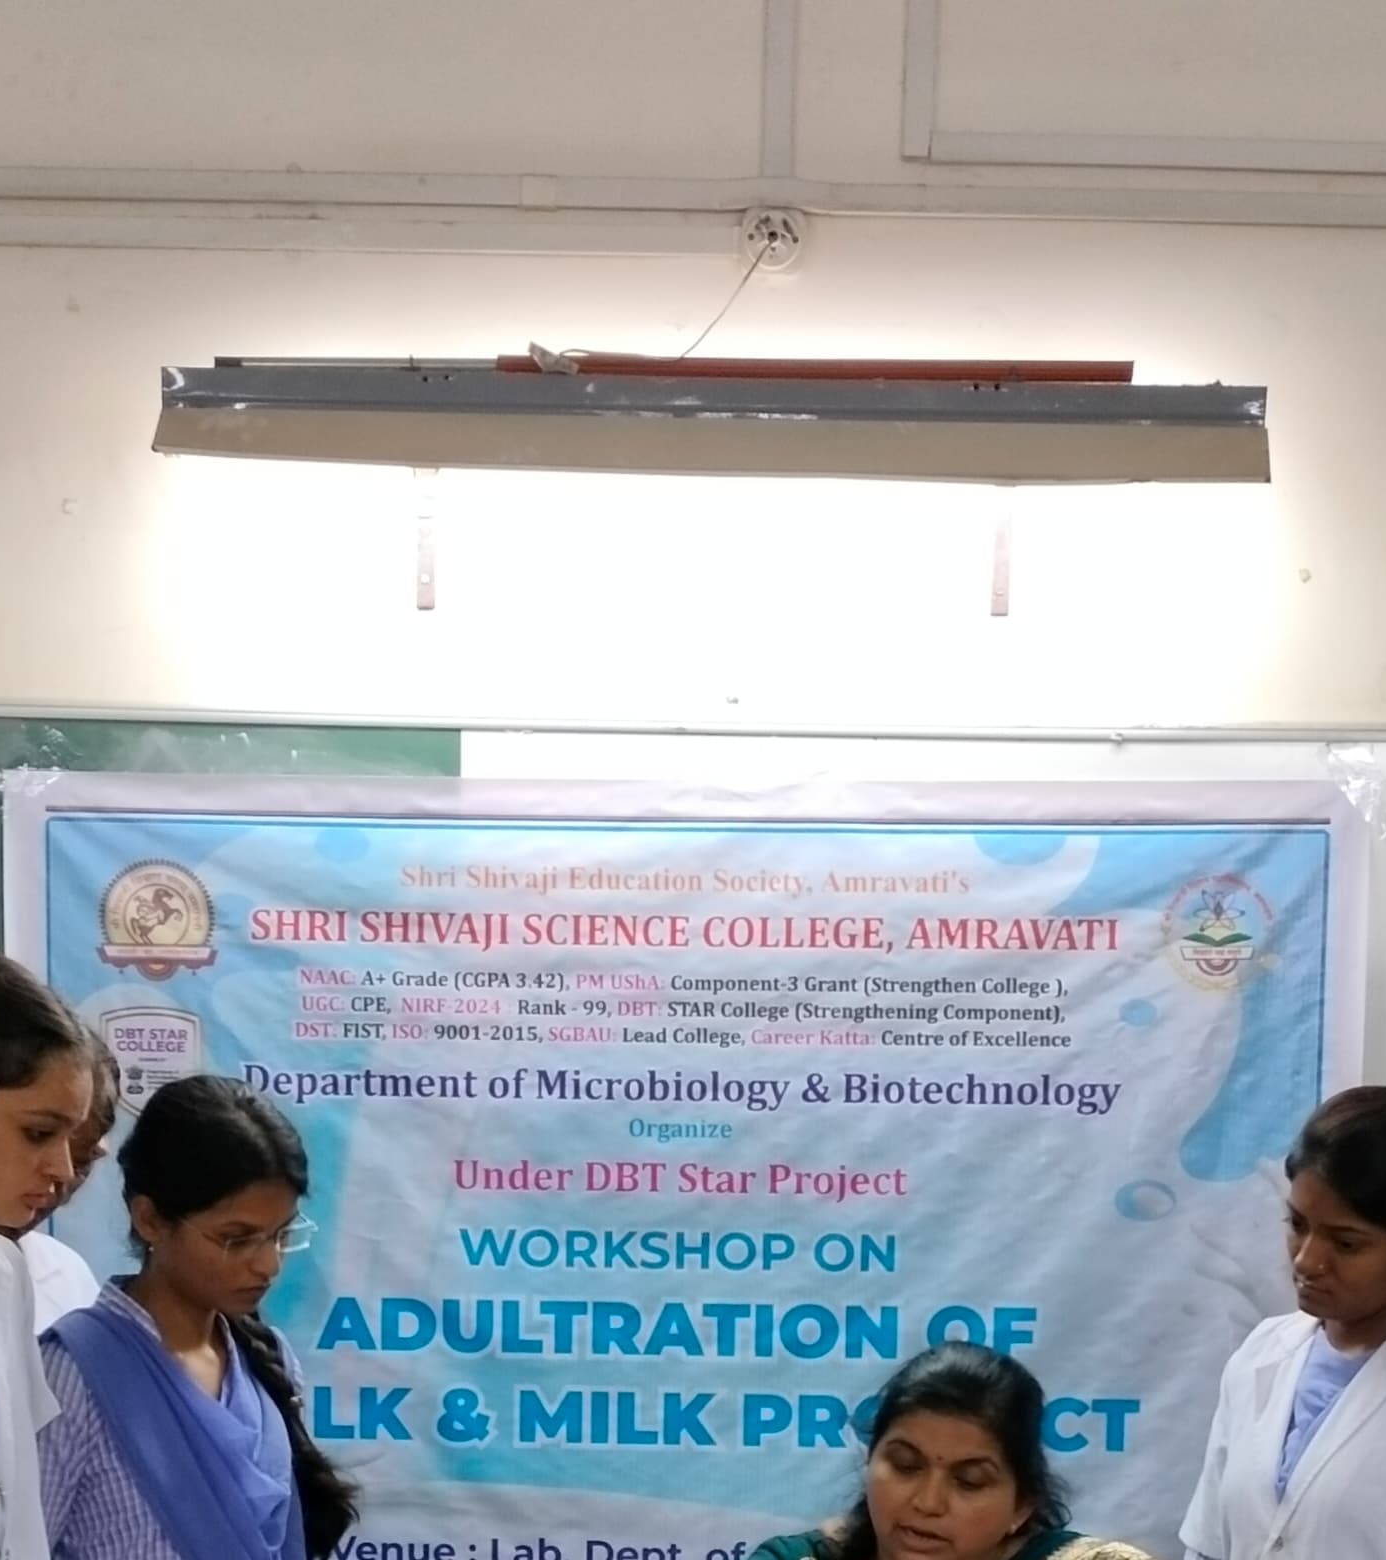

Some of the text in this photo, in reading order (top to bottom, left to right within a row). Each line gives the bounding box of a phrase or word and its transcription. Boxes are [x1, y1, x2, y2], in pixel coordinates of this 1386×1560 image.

[401, 866, 456, 889] Shri
[466, 866, 558, 895] Shivaji
[569, 867, 703, 892] Education
[822, 870, 970, 893] Amravati's
[251, 909, 1118, 954] SHRI SHIVAJI SCIENCE COLLEGE, AMRAVATI
[361, 971, 386, 987] A+
[392, 971, 448, 988] Grade
[454, 972, 511, 991] (CGPA
[515, 972, 570, 992] 3.42),
[576, 974, 604, 990] PM
[670, 975, 799, 995] Component-3
[804, 976, 857, 993] Grant
[863, 978, 977, 998] (Strengthen
[982, 978, 1051, 998] College
[350, 997, 391, 1015] CPE,
[517, 999, 566, 1016] Rank
[583, 1000, 612, 1019] 99,
[667, 1002, 714, 1018] STAR
[720, 1002, 789, 1022] College
[795, 1002, 939, 1024] (Strengthening
[942, 1005, 1066, 1025] Component),
[115, 1028, 188, 1041] DBT STAR
[116, 1040, 186, 1052] COLLEGE
[343, 1023, 387, 1041] FIST,
[433, 1024, 544, 1044] 9001-2015,
[622, 1027, 666, 1043] Lead
[672, 1028, 745, 1048] College,
[751, 1029, 813, 1046] Career
[881, 1031, 945, 1048] Centre
[949, 1030, 970, 1047] of
[973, 1031, 1071, 1048] Excellence
[243, 1063, 1122, 1116] Department of Microbiology & Biotechnology
[629, 1117, 733, 1143] Organize
[454, 1159, 908, 1204] Under DBT Star Project
[458, 1228, 896, 1273] WORKSHOP ON
[316, 1296, 1037, 1360] ADULTRATION OF
[436, 1387, 491, 1443] &
[518, 1389, 717, 1447] MILK
